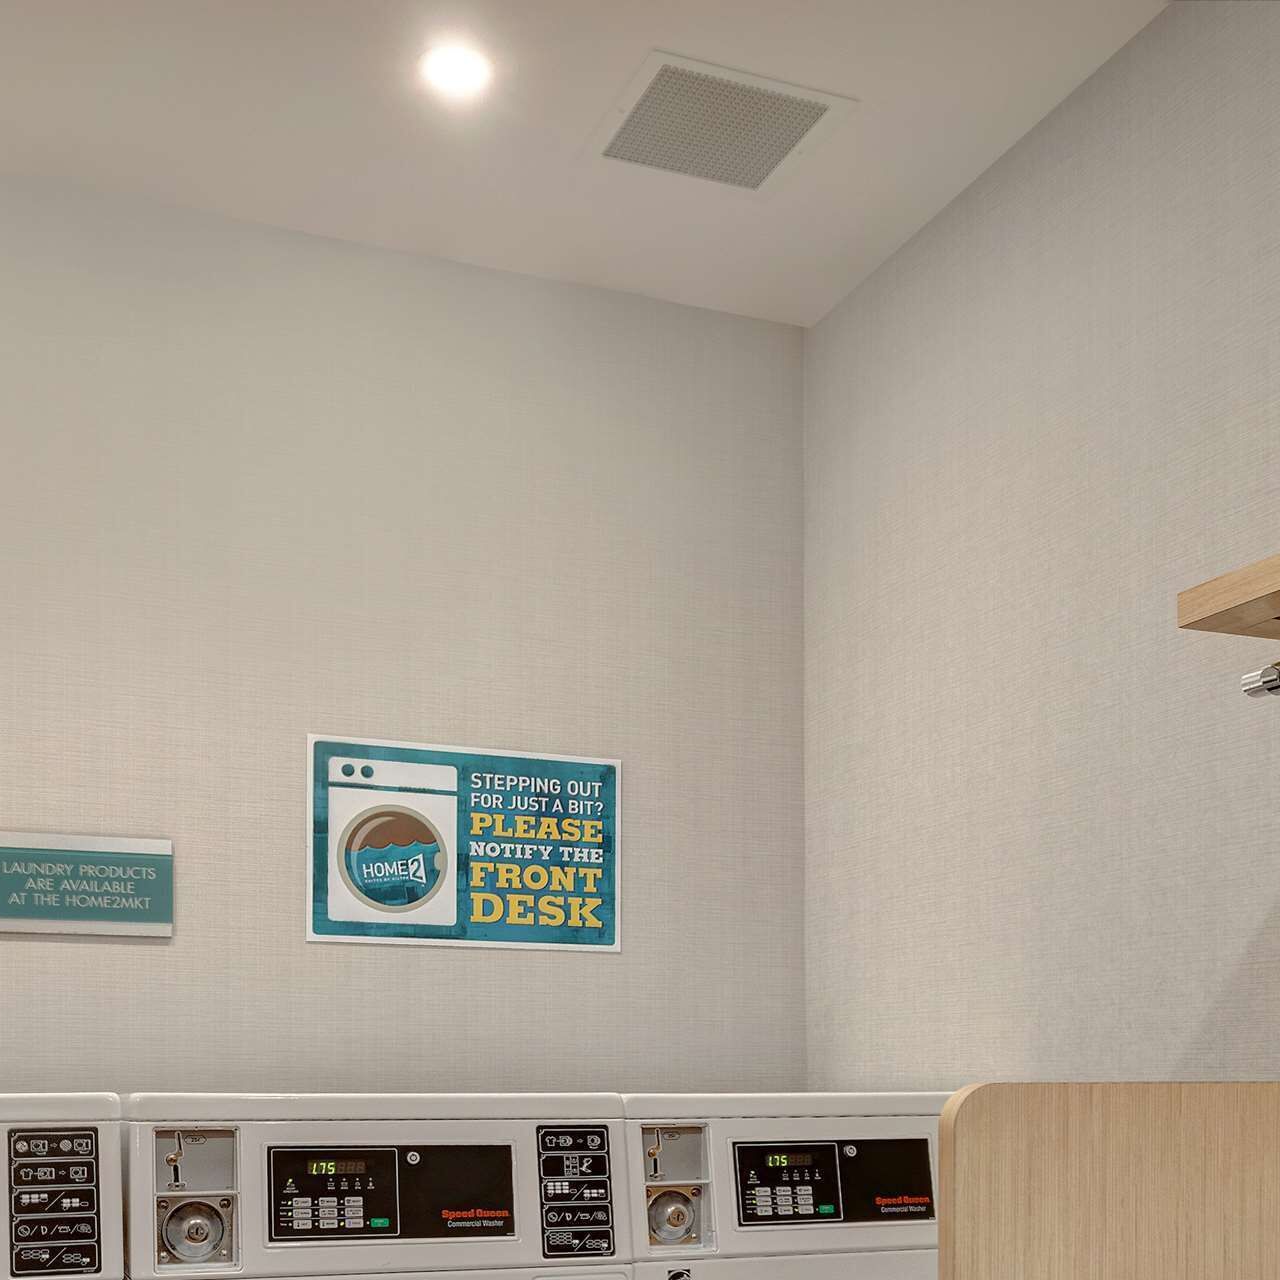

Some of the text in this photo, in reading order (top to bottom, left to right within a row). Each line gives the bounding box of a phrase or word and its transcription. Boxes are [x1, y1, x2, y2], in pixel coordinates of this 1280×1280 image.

[471, 773, 603, 798] STEPPING OUT
[471, 792, 604, 816] FOR JUST A BIT?
[470, 812, 603, 843] PLEASE
[470, 841, 603, 864] NOTIFY THE
[2, 861, 157, 880] LAUNDRY PRODUCTS
[470, 861, 603, 893] FRONT
[24, 878, 136, 894] ARE AVAILABLE
[8, 892, 152, 910] AT THE HOME2MKT
[470, 892, 603, 928] DESK
[441, 1209, 510, 1220] Speed Queen
[447, 1219, 504, 1228] Commercial Washer
